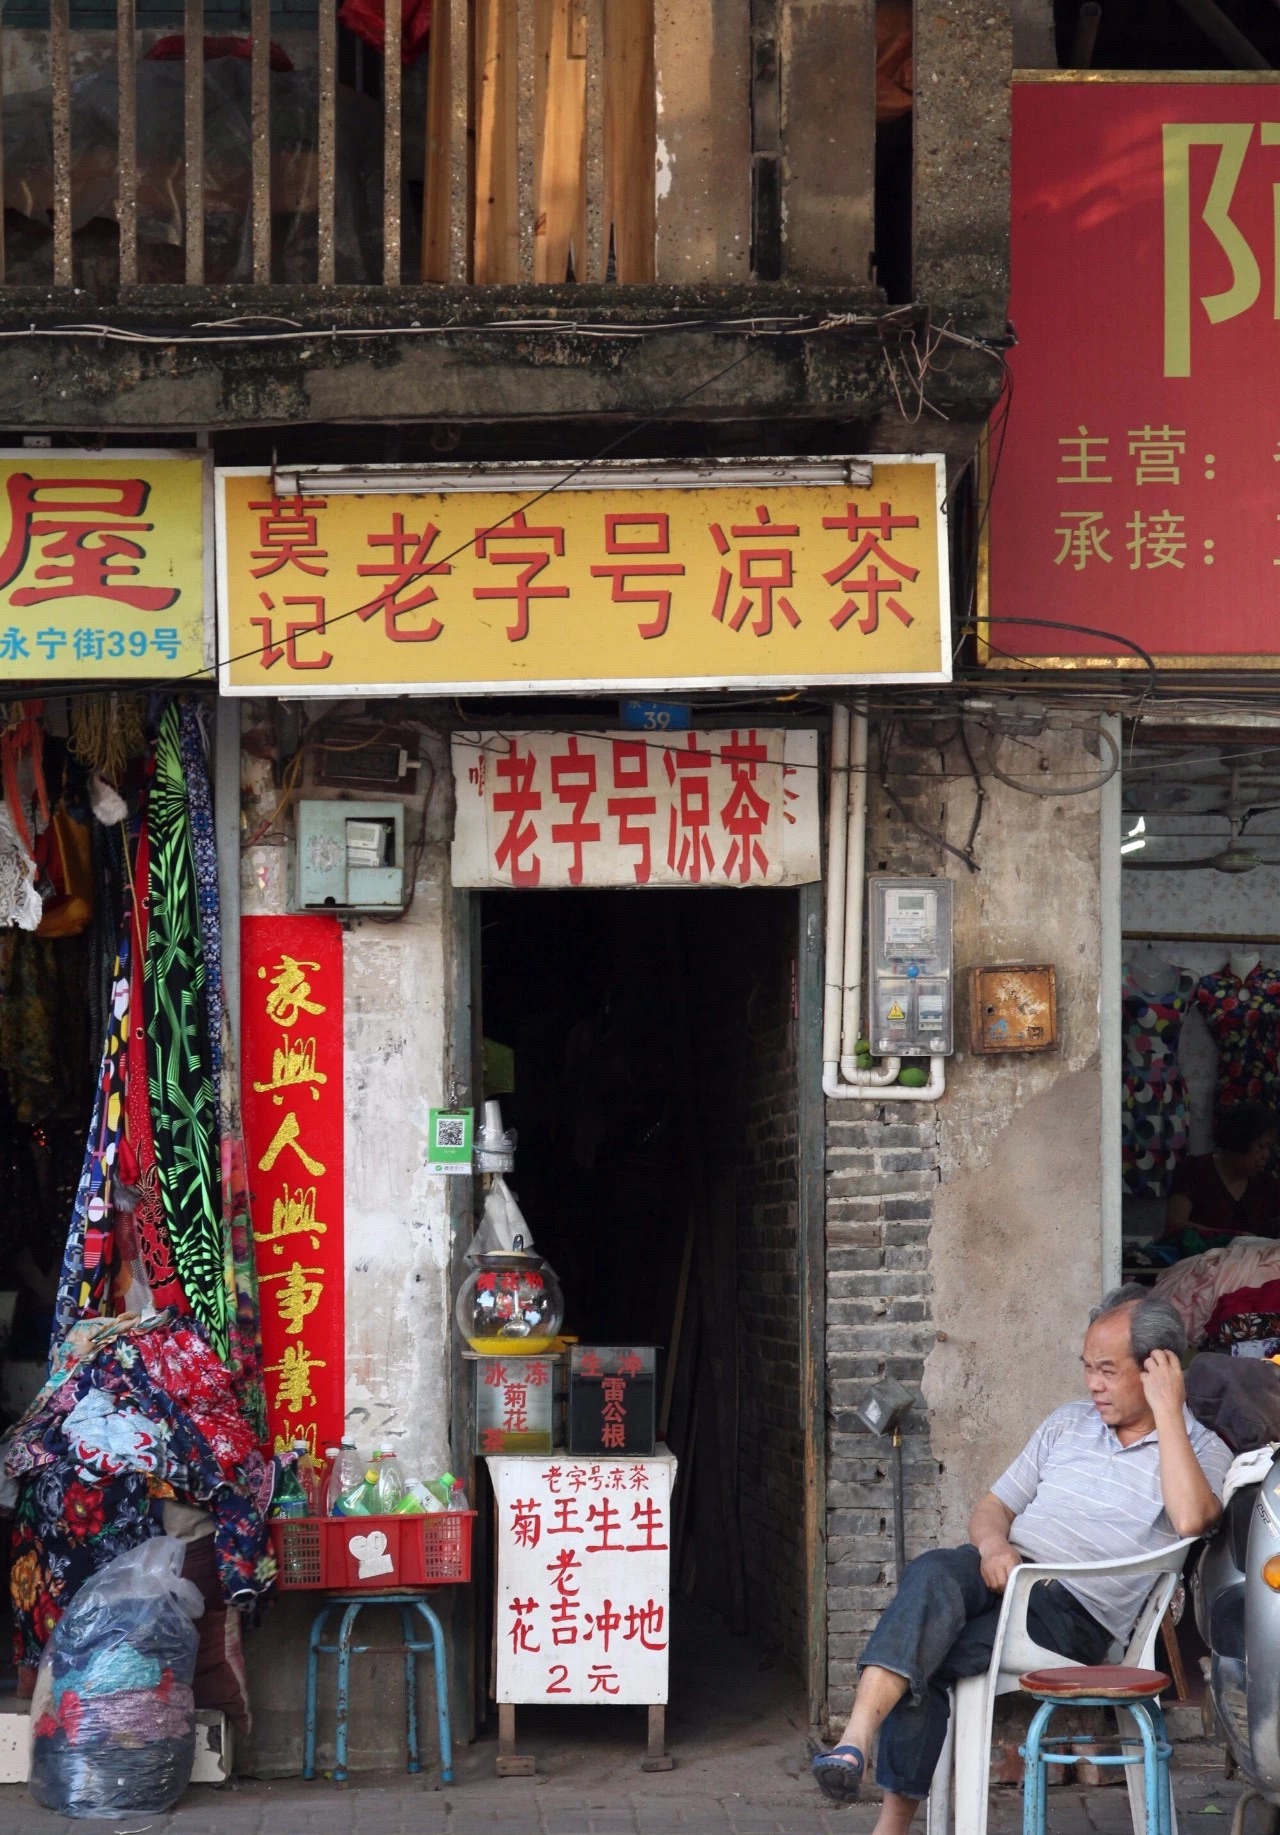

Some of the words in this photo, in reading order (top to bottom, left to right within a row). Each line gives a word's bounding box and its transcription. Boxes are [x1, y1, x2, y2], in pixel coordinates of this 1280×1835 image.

[0, 474, 181, 611] 屋
[247, 497, 332, 670] 莫记
[357, 498, 919, 643] 老字号凉茶
[0, 627, 181, 661] 永宁街39号
[643, 712, 670, 729] 39
[493, 729, 769, 887] 老字号凉茶
[502, 1383, 529, 1434] 菊花
[542, 1465, 649, 1493] 老字号凉茶
[601, 1377, 627, 1448] 雷公根
[508, 1497, 542, 1655] 菊花
[547, 1497, 584, 1646] 王老吉
[583, 1497, 625, 1653] 生冲
[623, 1497, 669, 1651] 生地
